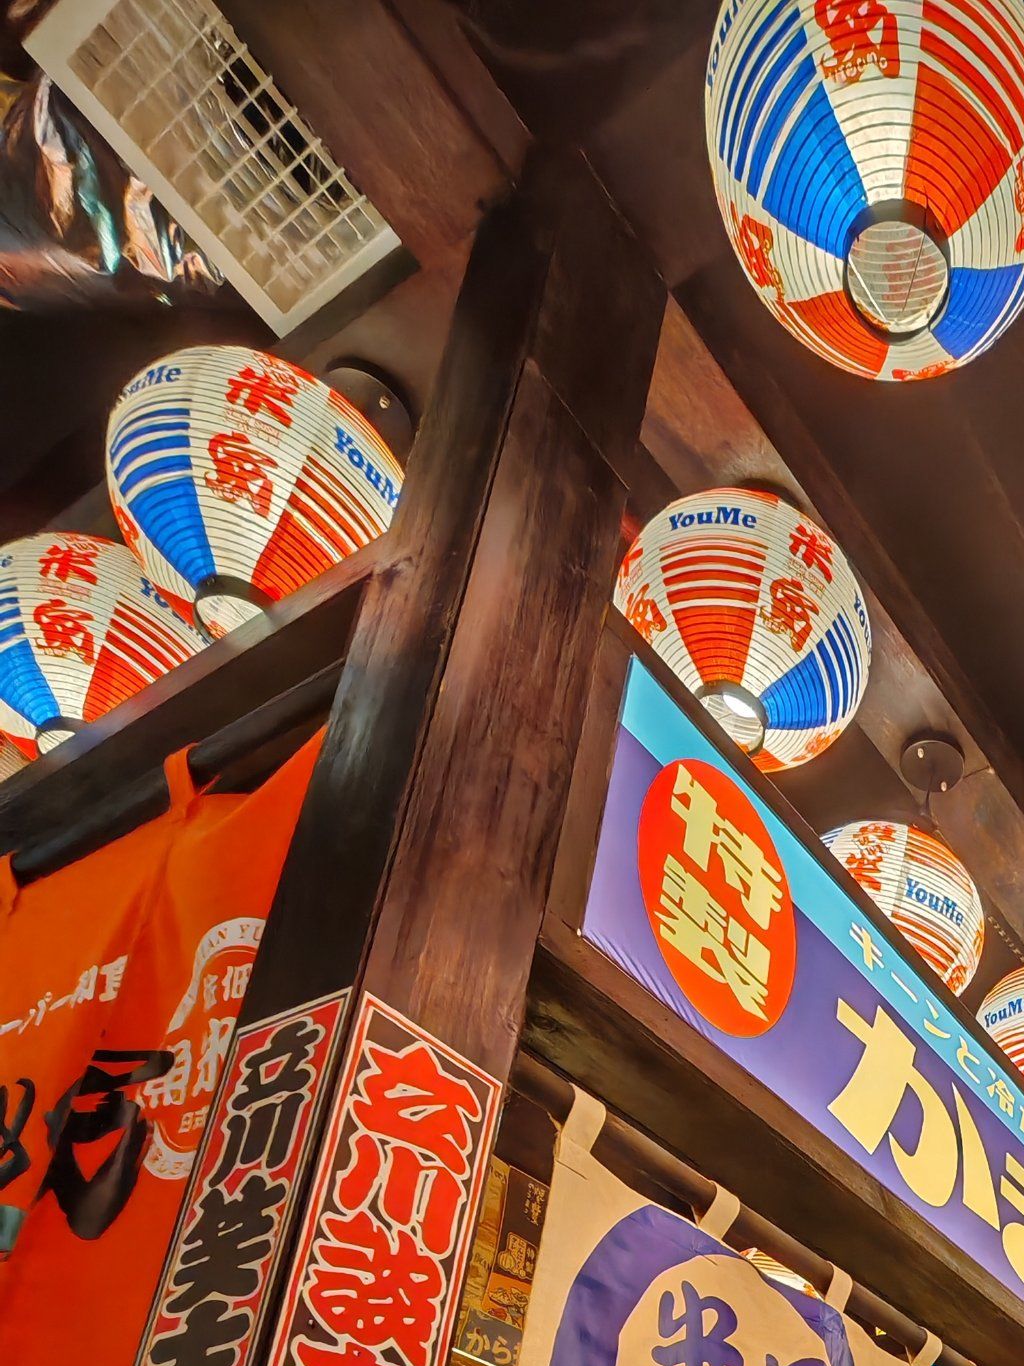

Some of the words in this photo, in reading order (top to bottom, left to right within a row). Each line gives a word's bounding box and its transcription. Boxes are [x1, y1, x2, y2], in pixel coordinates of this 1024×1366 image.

[668, 506, 757, 531] YouMe
[658, 762, 784, 1020] 特製
[904, 877, 965, 928] YouMe
